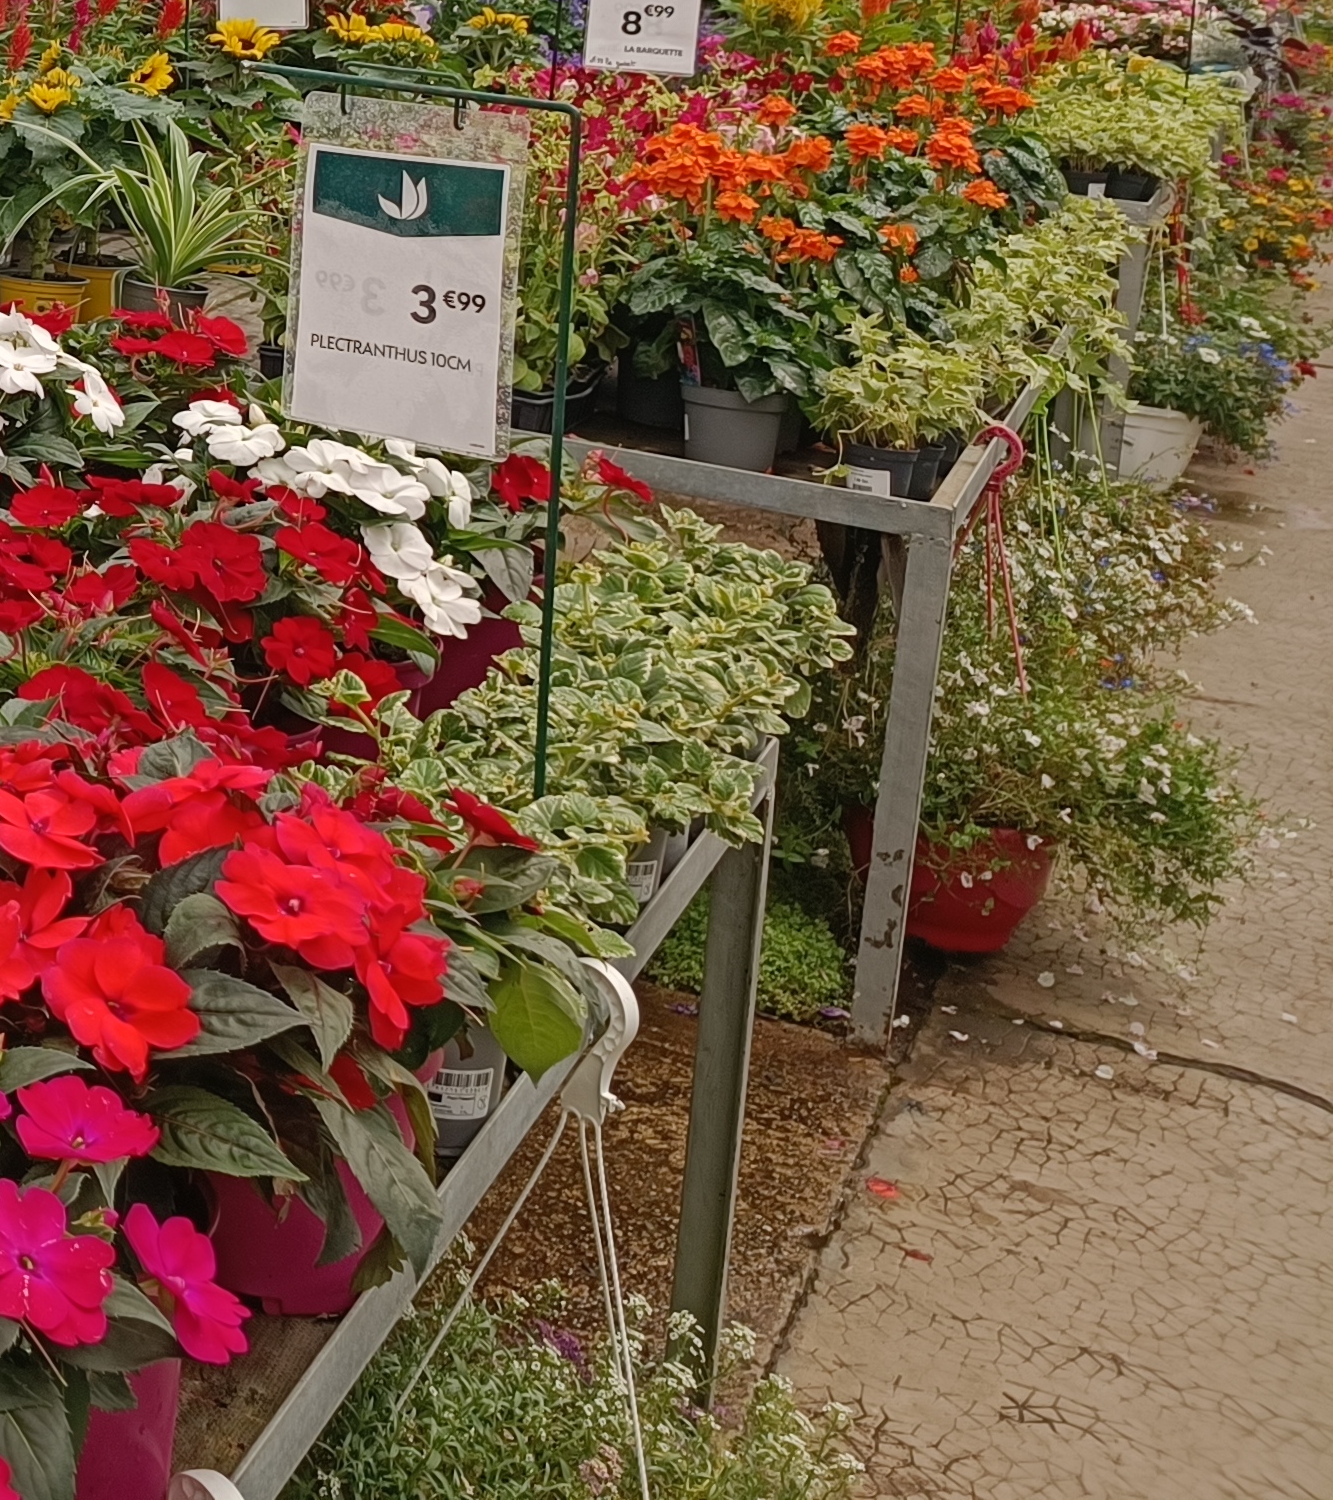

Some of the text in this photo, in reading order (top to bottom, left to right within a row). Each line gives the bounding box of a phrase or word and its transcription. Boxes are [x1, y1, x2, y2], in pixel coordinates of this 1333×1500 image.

[623, 45, 683, 57] LA BARQUETTE
[310, 333, 472, 373] PLECTRANTHUS 10CM
